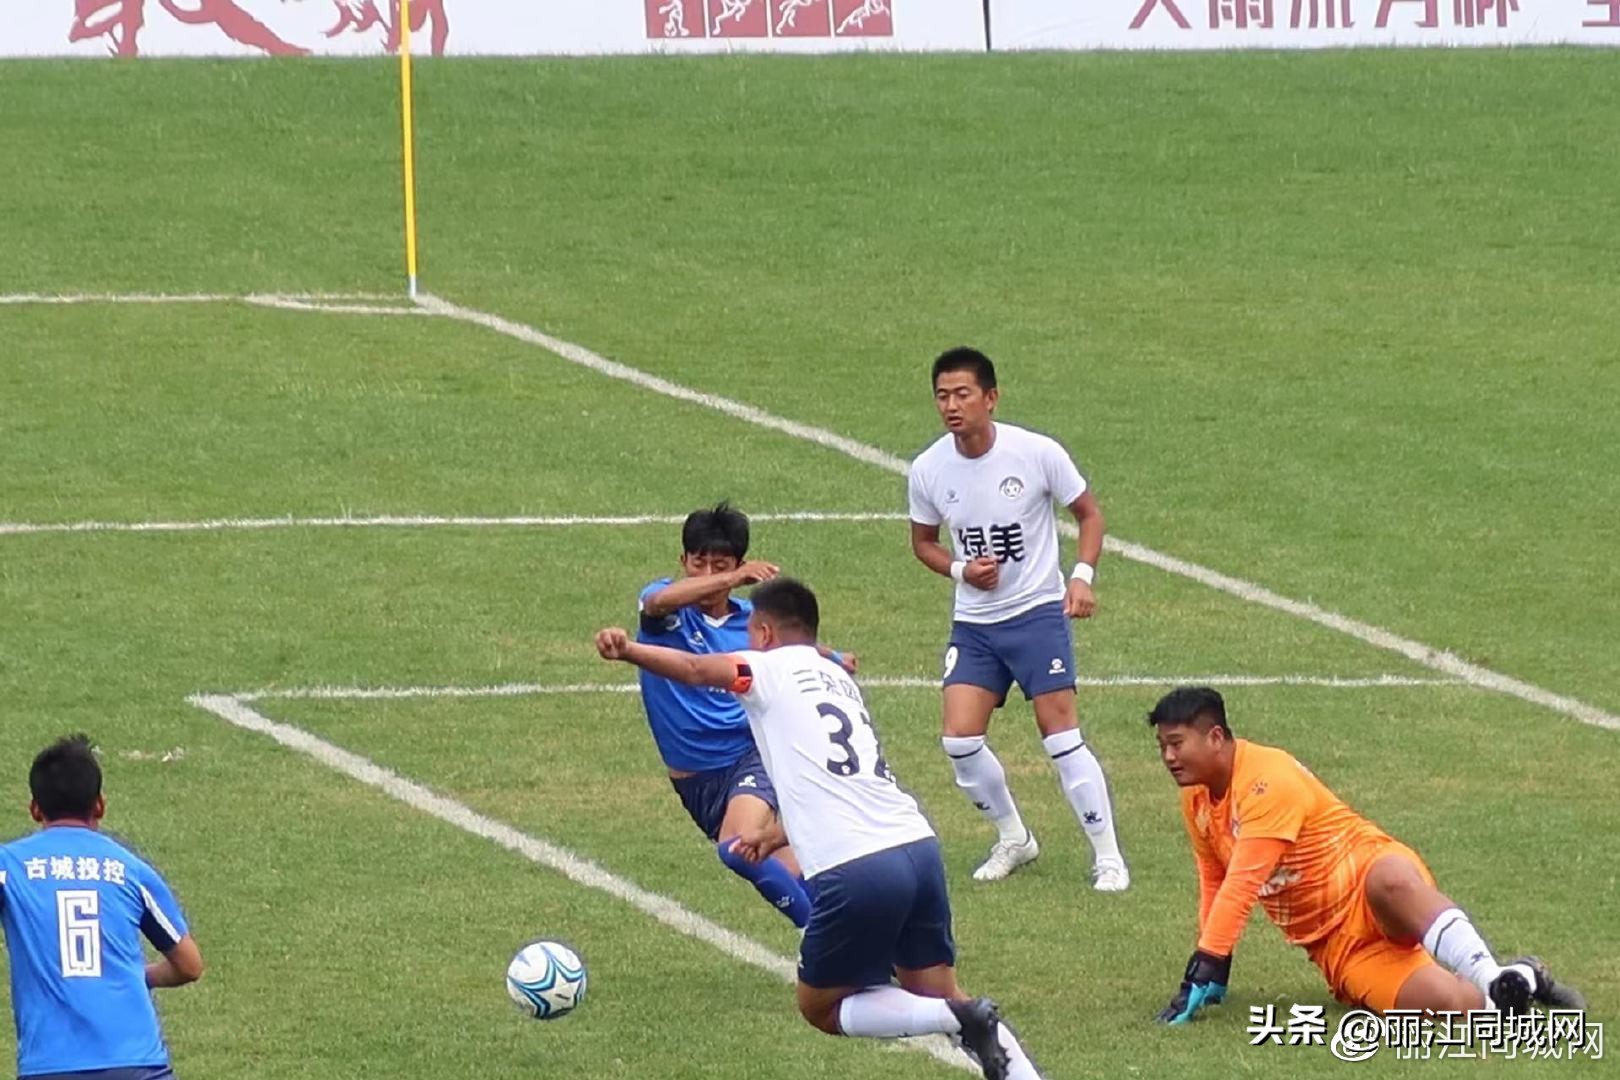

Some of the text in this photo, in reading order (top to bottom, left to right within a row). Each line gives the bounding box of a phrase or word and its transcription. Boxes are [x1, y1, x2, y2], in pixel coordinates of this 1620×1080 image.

[958, 522, 1025, 563] 绿美
[24, 856, 125, 885] 古城投控
[56, 889, 101, 978] 6
